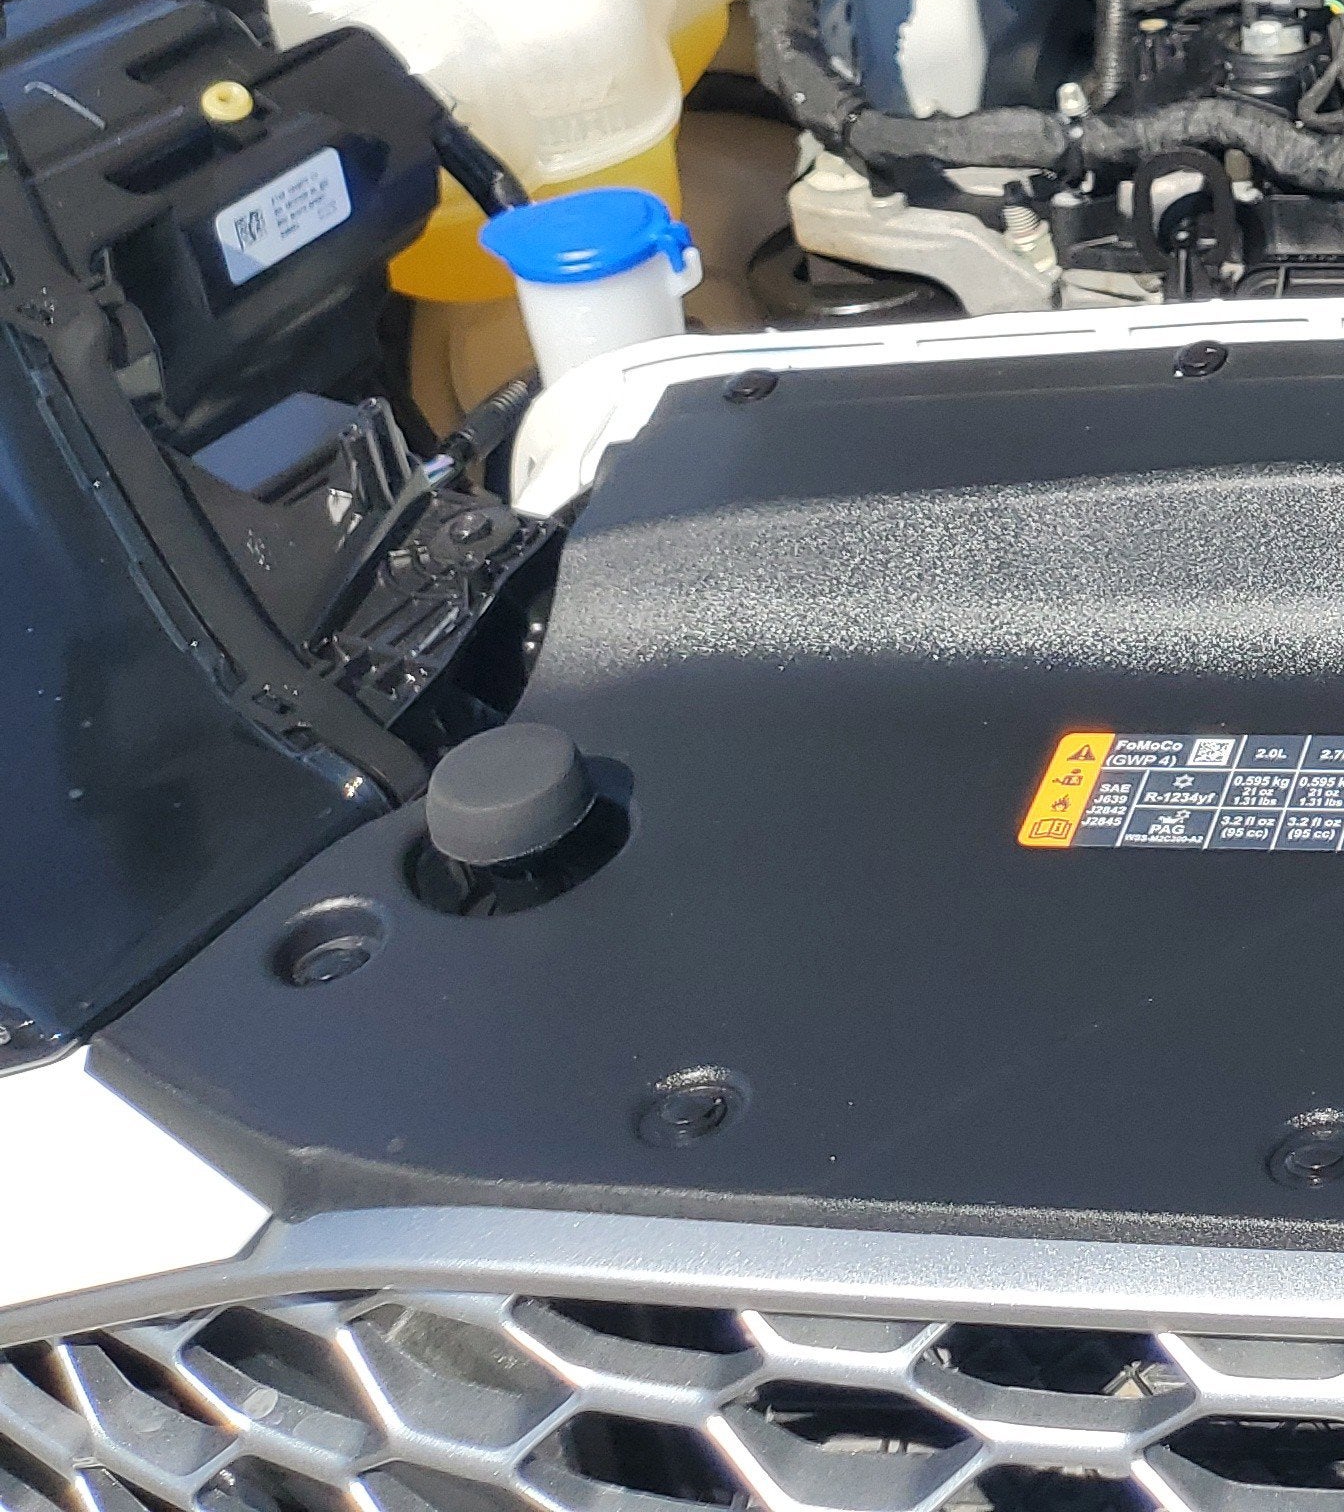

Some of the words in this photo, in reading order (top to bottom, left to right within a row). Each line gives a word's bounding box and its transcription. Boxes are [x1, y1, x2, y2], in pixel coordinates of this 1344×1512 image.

[1114, 740, 1183, 752] FoMoCo
[1255, 748, 1287, 759] 2.0L
[1105, 755, 1156, 767] (GWP
[1157, 755, 1177, 768] 4)
[1233, 775, 1270, 786] 0.595
[1272, 776, 1290, 789] kg
[1299, 776, 1335, 787] 0.595
[1100, 783, 1131, 793] SAE
[1242, 788, 1256, 796] 21
[1259, 789, 1274, 797] oz
[1308, 788, 1321, 796] 21
[1325, 789, 1339, 797] oz
[1094, 795, 1127, 804] J639
[1144, 792, 1218, 805] R-1234yf
[1233, 797, 1257, 806] 1.31
[1259, 797, 1277, 806] lbs
[1299, 797, 1323, 806] 1.31
[1325, 797, 1343, 807] lbs
[1220, 816, 1241, 826] 3.2
[1244, 816, 1256, 826] fl
[1258, 818, 1275, 826] oz
[1287, 817, 1309, 826] 3.2
[1310, 817, 1322, 827] fl
[1324, 818, 1342, 827] oz
[1148, 825, 1185, 835] PAG
[1221, 827, 1244, 838] (95
[1246, 828, 1268, 839] cc)
[1288, 828, 1311, 839] (95
[1313, 829, 1335, 840] cc)
